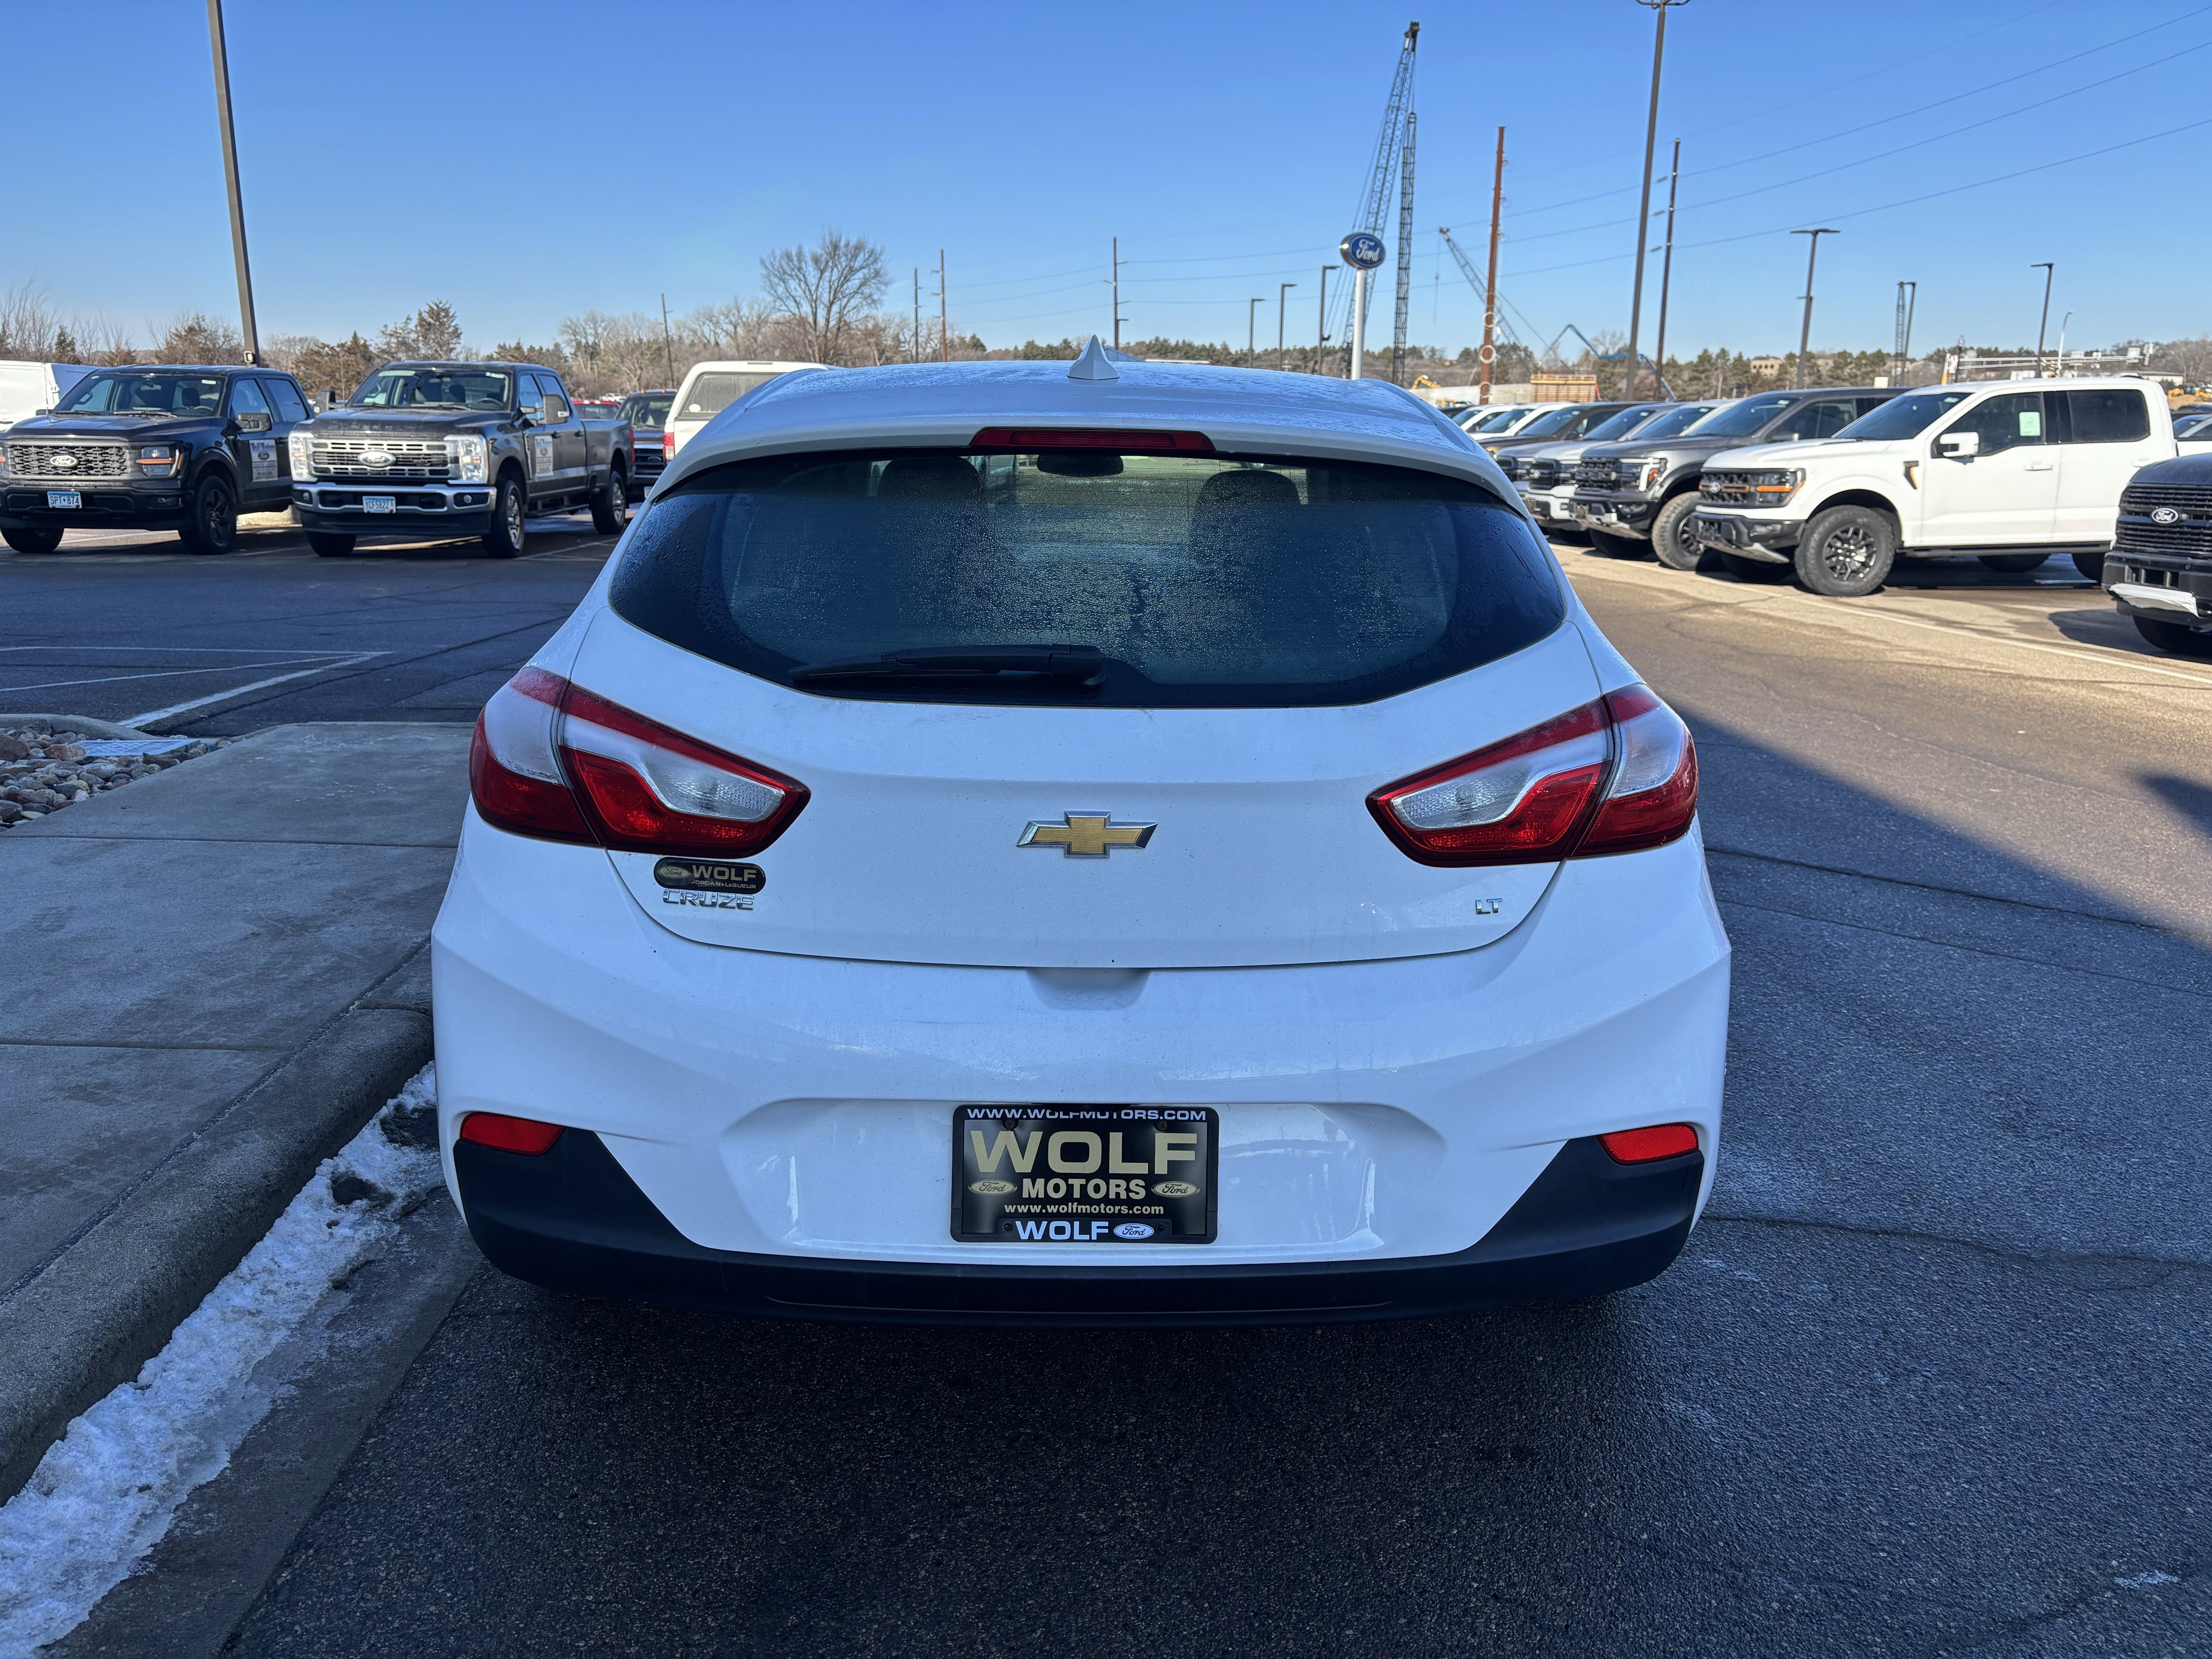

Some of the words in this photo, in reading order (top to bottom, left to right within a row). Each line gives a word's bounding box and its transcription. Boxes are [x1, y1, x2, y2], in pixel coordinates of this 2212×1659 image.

[1356, 239, 1380, 262] Ford
[50, 496, 62, 504] SPT
[665, 868, 683, 876] Ford
[692, 865, 757, 882] WOLF
[663, 889, 754, 910] CRUZE
[1475, 898, 1503, 915] LT
[970, 1130, 1197, 1174] WOLF
[1022, 1178, 1146, 1199] MOTORS
[1004, 1202, 1164, 1214] www.wolfmotors.com
[1015, 1221, 1109, 1240] WOLF
